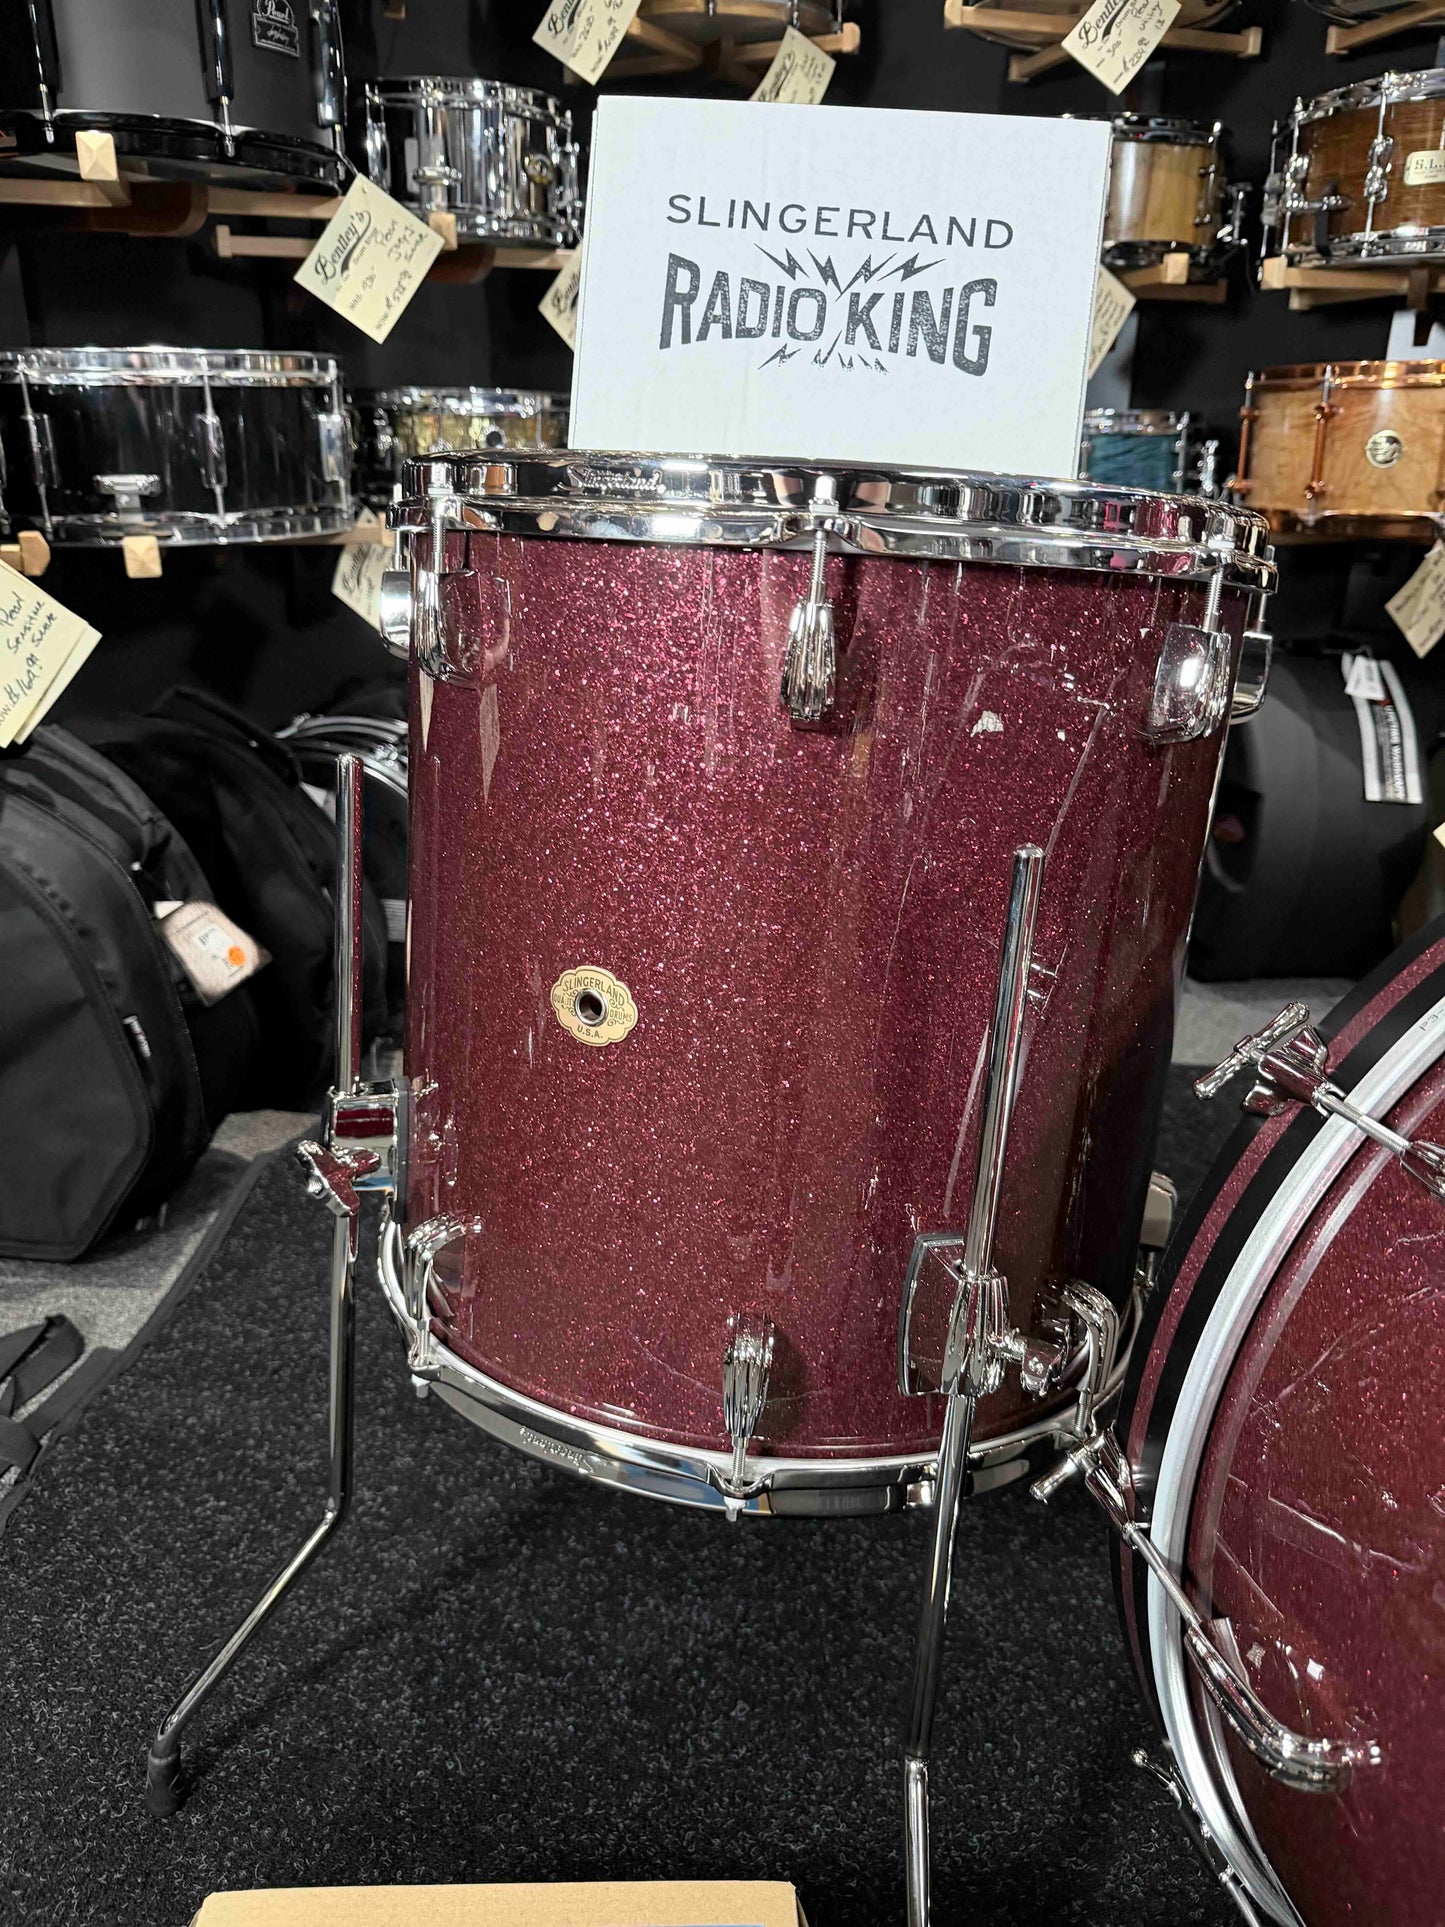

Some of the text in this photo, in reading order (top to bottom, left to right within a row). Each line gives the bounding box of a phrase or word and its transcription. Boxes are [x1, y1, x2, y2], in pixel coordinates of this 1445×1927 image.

[666, 194, 1014, 249] SLINGERLAND
[314, 210, 371, 285] Bentley's
[659, 252, 827, 350] RADIO
[845, 278, 998, 377] KING
[562, 976, 625, 1006] SLINGERLAND
[577, 1024, 603, 1039] U.S.A.
[609, 1009, 633, 1022] DRUMS
